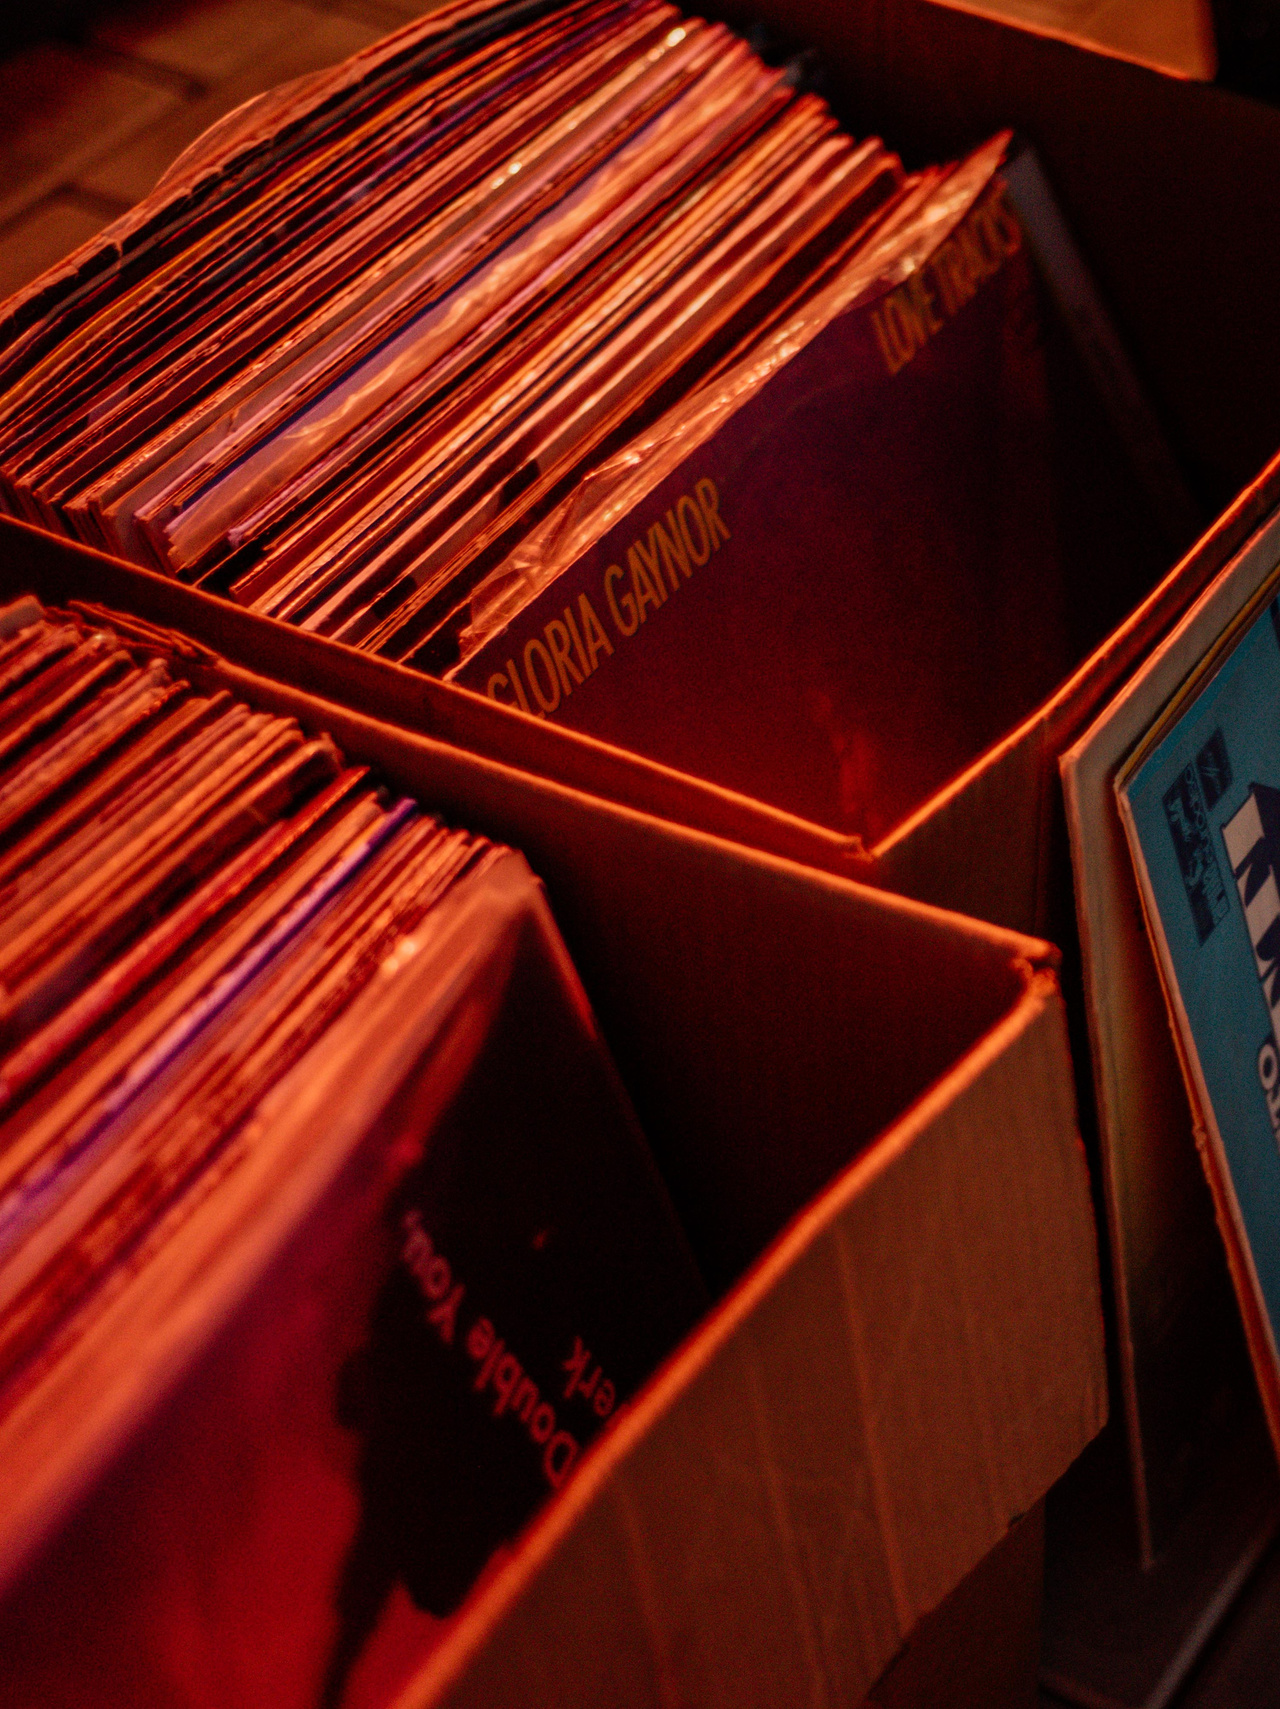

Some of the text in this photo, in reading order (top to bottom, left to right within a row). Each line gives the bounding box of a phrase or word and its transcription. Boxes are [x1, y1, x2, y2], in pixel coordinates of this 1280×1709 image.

[871, 270, 944, 377] LOVE
[603, 477, 732, 637] GAYNOR
[465, 1315, 582, 1489] Double
